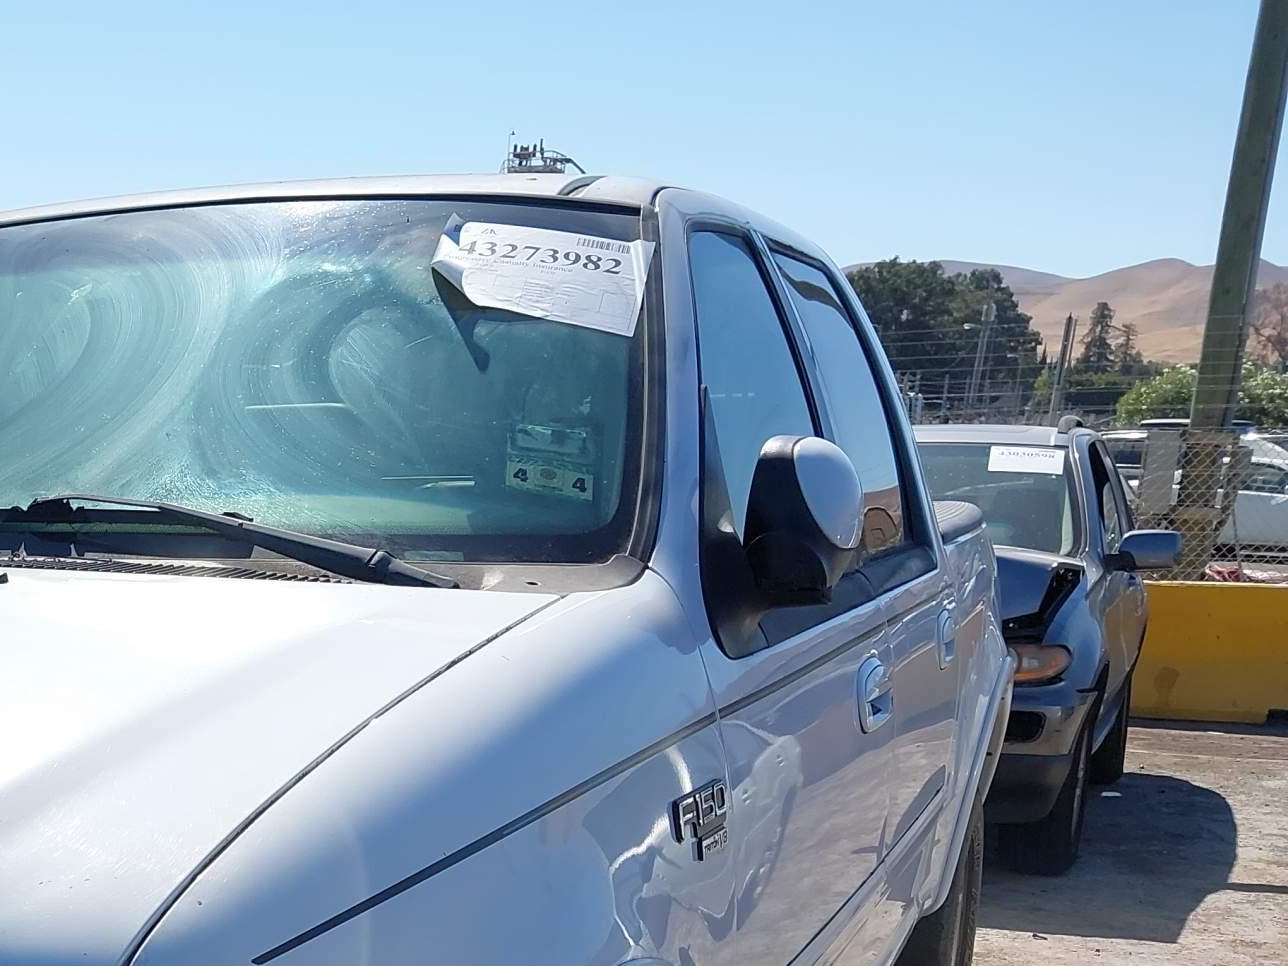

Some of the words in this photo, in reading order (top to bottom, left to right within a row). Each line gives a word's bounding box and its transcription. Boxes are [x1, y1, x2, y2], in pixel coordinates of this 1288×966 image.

[458, 239, 623, 275] 43273982
[513, 468, 528, 482] 4
[572, 477, 588, 492] 4
